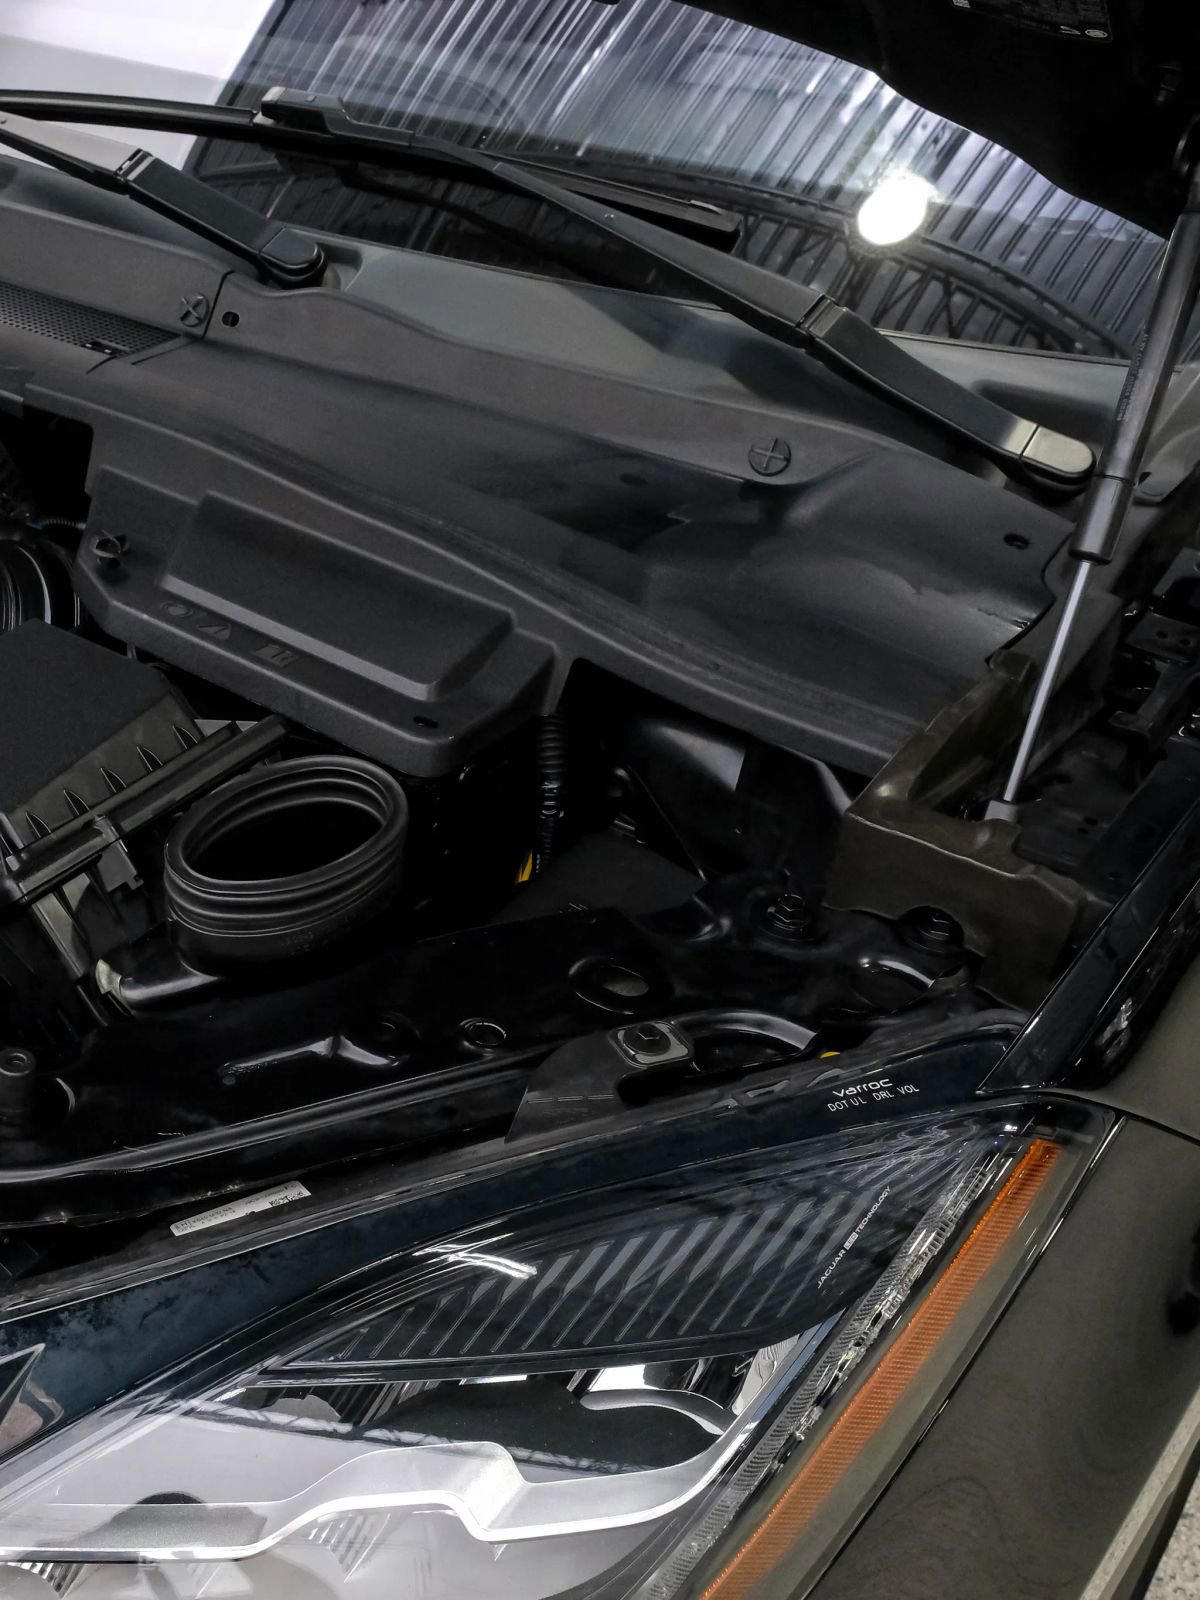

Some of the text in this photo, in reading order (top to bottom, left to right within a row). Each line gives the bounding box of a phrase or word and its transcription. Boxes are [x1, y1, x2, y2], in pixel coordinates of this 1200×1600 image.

[827, 1100, 849, 1112] DOT
[872, 1090, 895, 1101] DRL
[896, 1084, 920, 1095] VOL
[832, 1078, 893, 1097] varroc
[817, 1249, 847, 1289] JAGUAR
[855, 1185, 891, 1233] TECHNOLOGY
